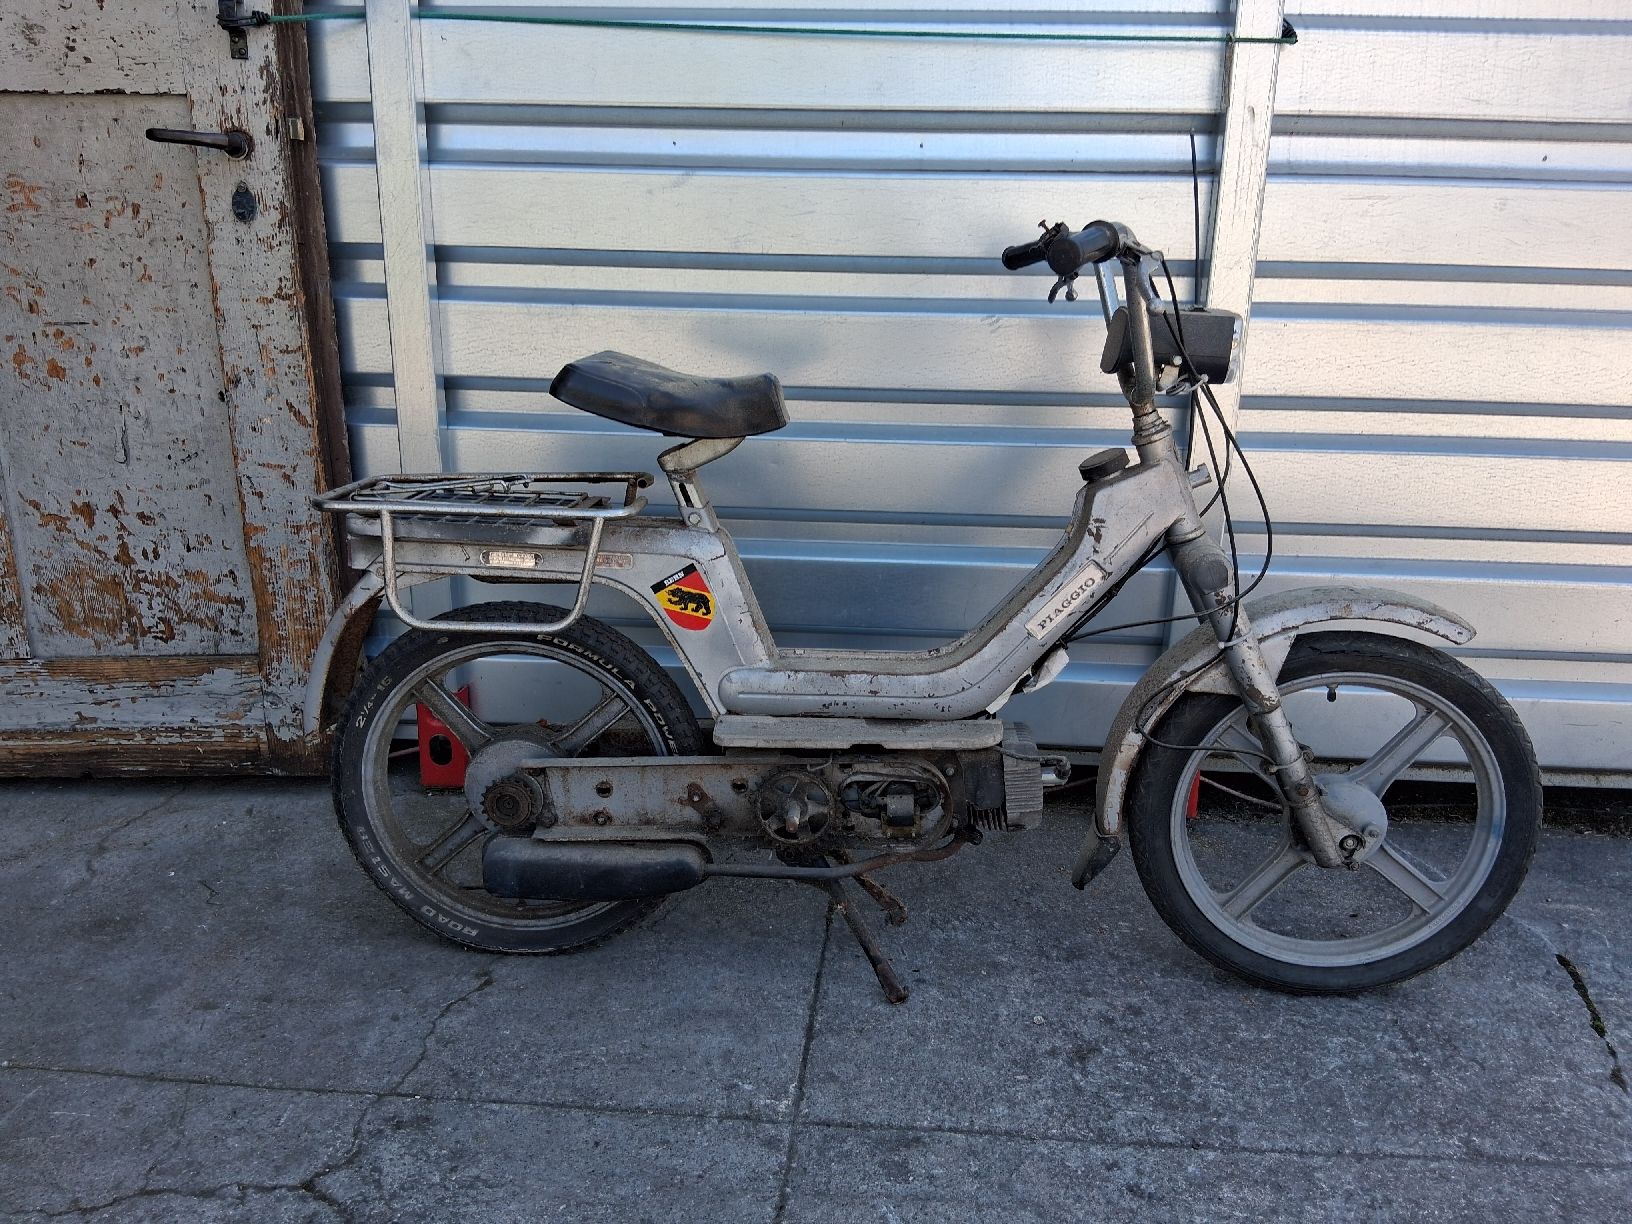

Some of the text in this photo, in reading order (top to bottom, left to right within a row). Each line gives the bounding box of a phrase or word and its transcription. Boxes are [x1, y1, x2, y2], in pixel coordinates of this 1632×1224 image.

[663, 570, 685, 587] BERN
[1037, 577, 1097, 631] PIAGGIO
[536, 633, 637, 691] FORMULA
[420, 904, 480, 938] ROAD
